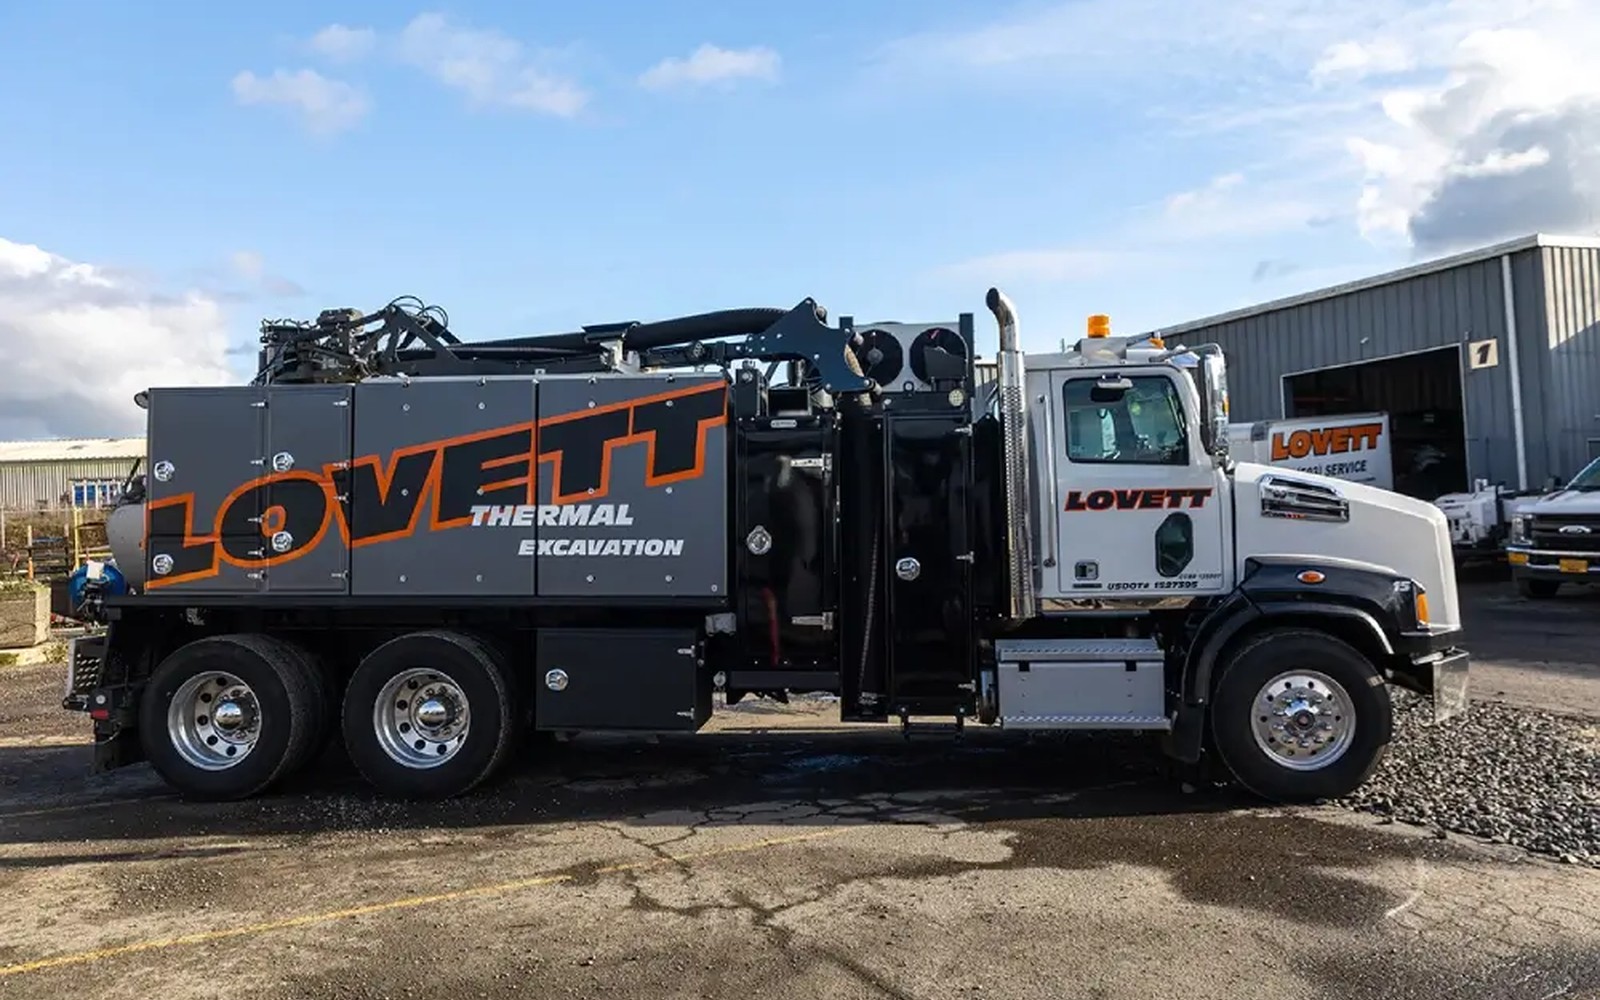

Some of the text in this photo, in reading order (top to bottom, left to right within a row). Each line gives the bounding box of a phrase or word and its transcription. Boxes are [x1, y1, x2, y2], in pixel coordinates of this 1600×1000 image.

[1477, 343, 1491, 365] 1
[1271, 423, 1383, 462] LOVETT
[1325, 459, 1367, 477] SERVICE
[145, 380, 729, 590] LOVETT
[1064, 487, 1213, 512] LOVETT
[469, 504, 634, 527] THERMAL
[517, 538, 685, 556] EXCAVATION
[1107, 582, 1150, 591] USDOT#
[1393, 580, 1411, 592] 15
